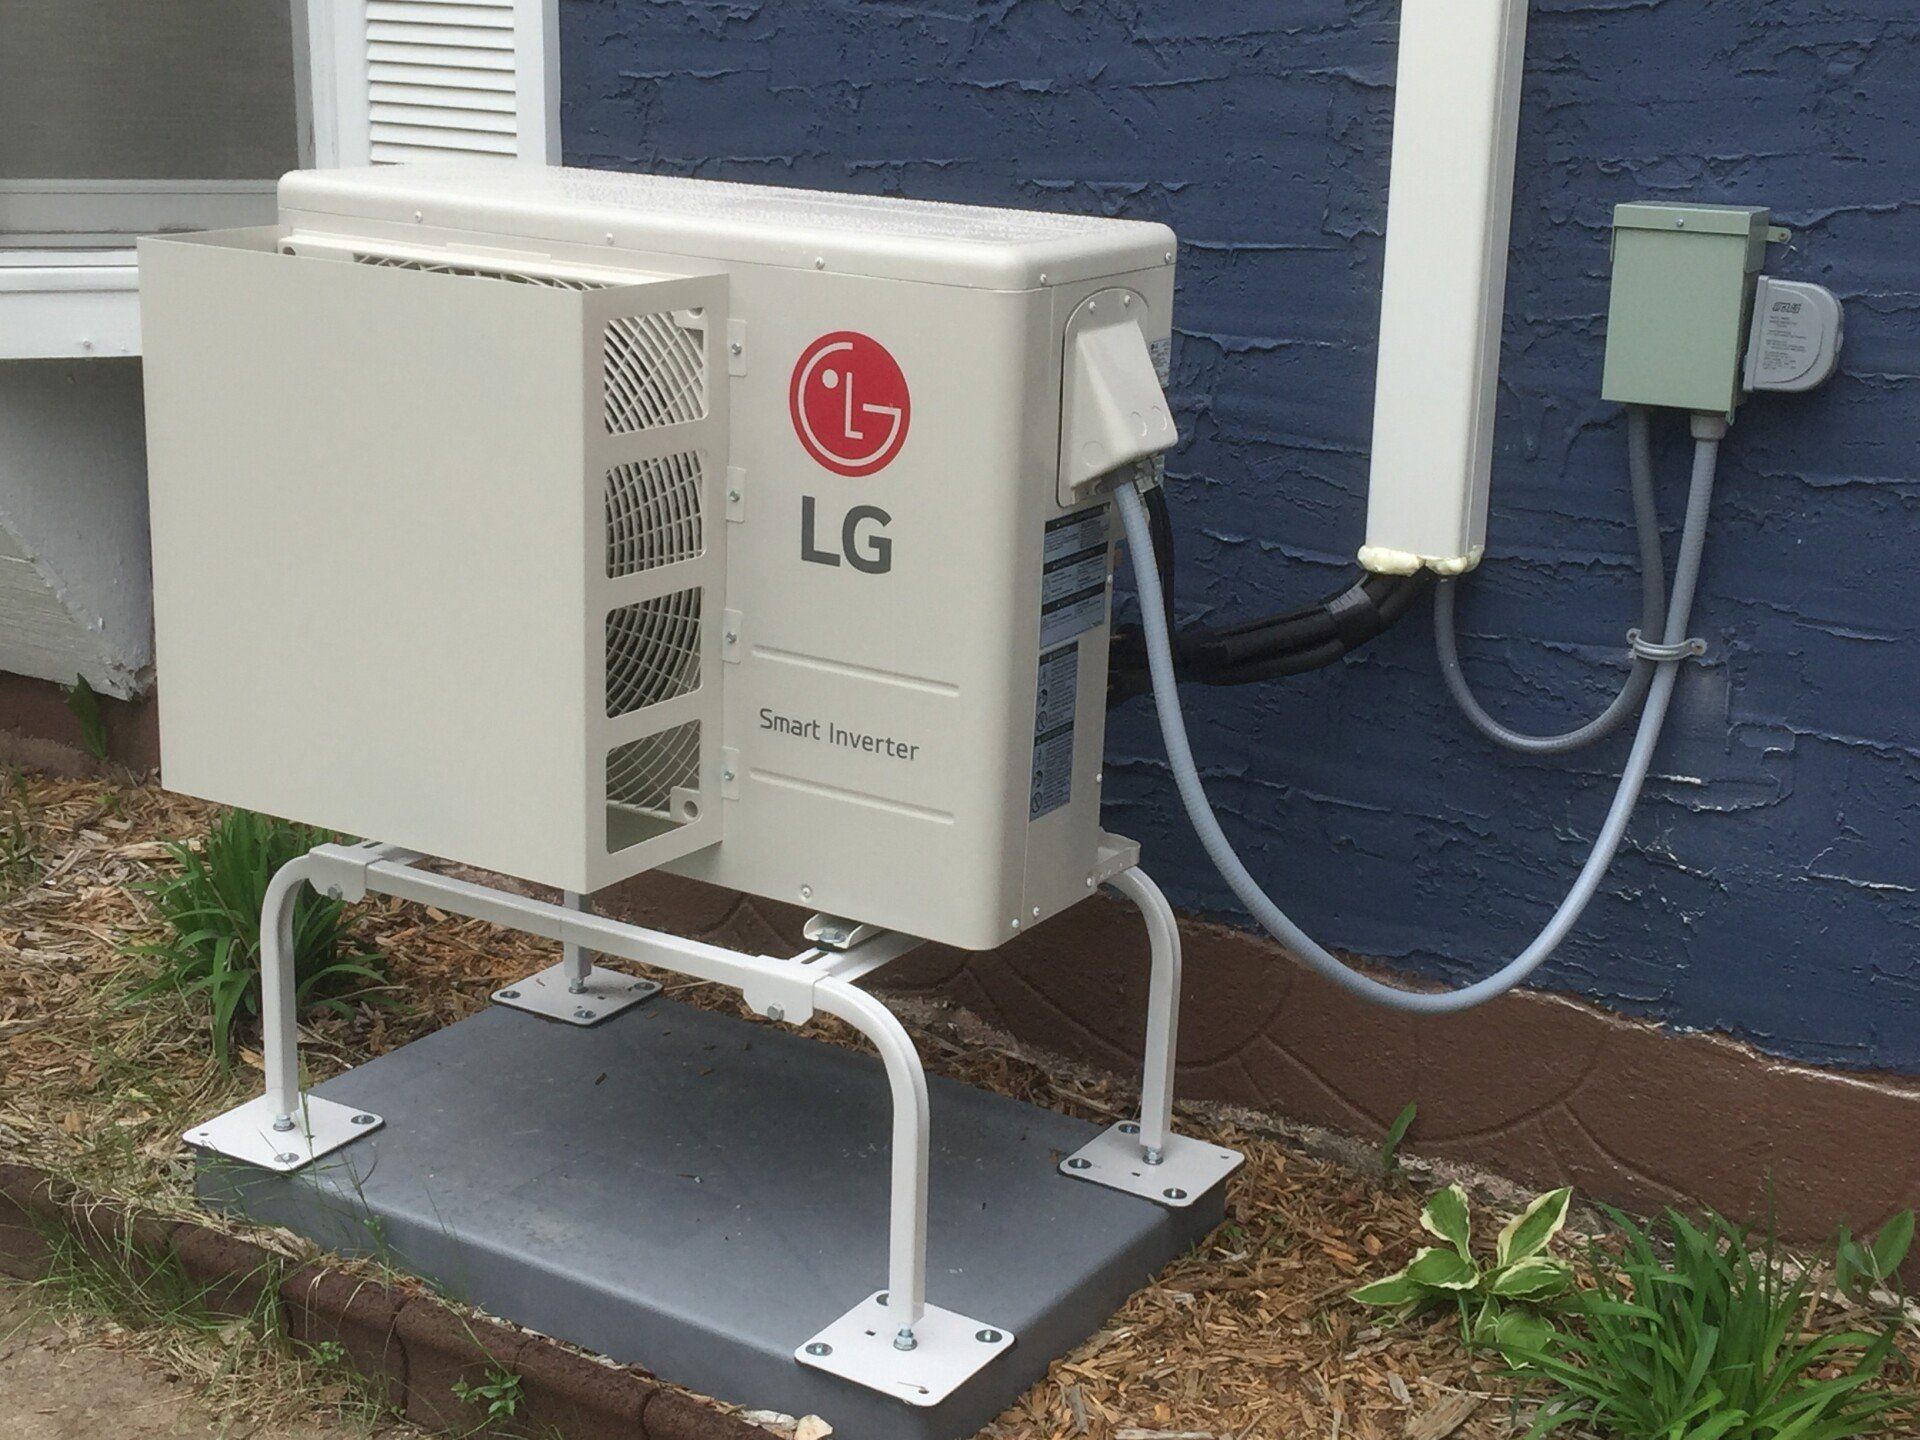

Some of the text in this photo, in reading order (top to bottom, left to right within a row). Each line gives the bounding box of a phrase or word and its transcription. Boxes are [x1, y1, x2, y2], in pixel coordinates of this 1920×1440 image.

[801, 495, 892, 574] LG
[760, 708, 920, 761] Smart Inverter
